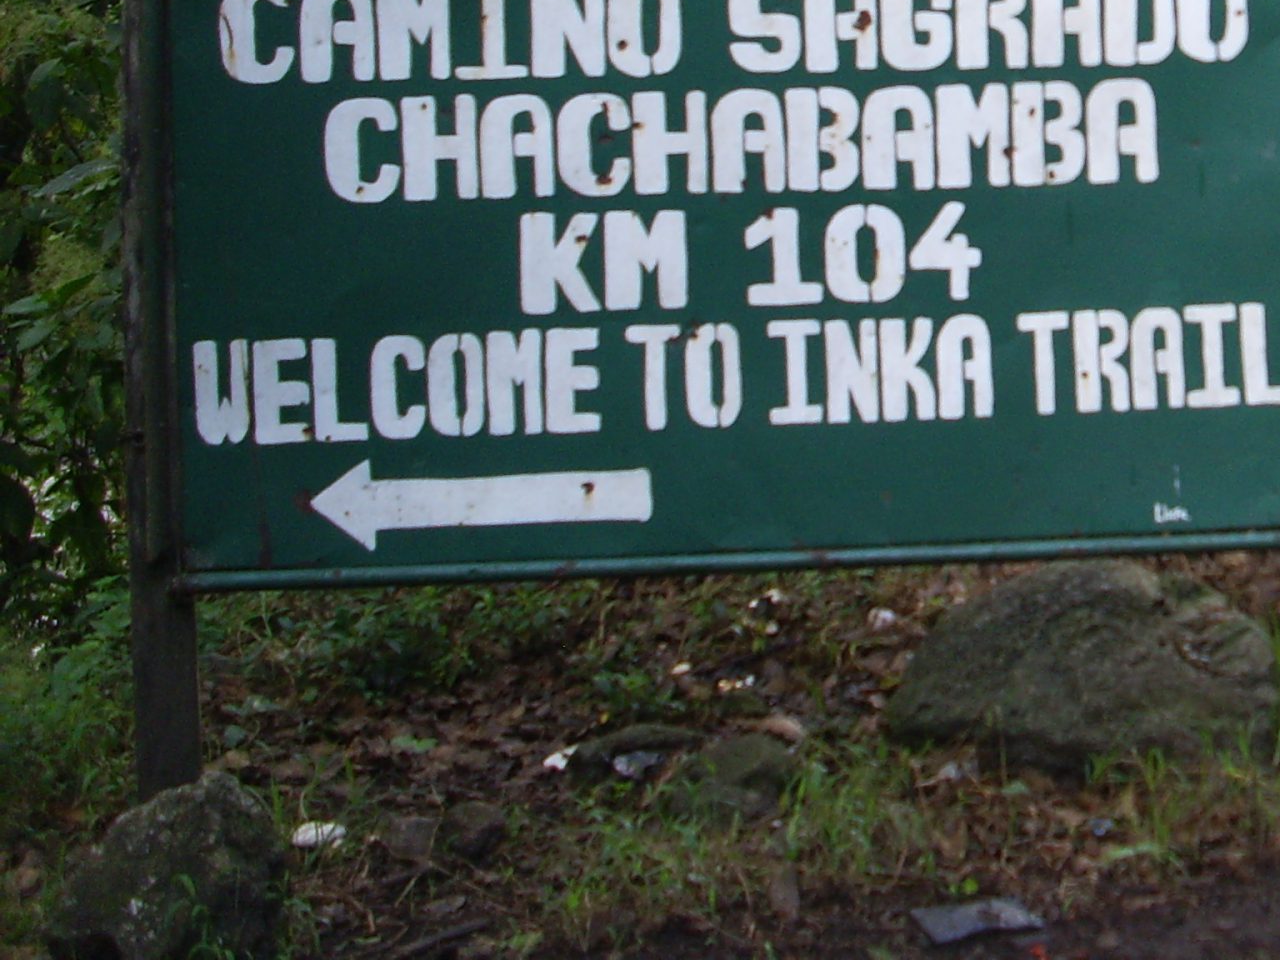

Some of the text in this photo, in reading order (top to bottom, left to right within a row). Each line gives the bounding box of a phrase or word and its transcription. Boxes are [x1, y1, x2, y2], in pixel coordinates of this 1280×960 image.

[323, 76, 1160, 204] CHACHABAMBA
[519, 200, 983, 316] KM 104
[192, 327, 602, 445] WELCOME
[624, 322, 742, 431] TO
[766, 312, 995, 426] INKA
